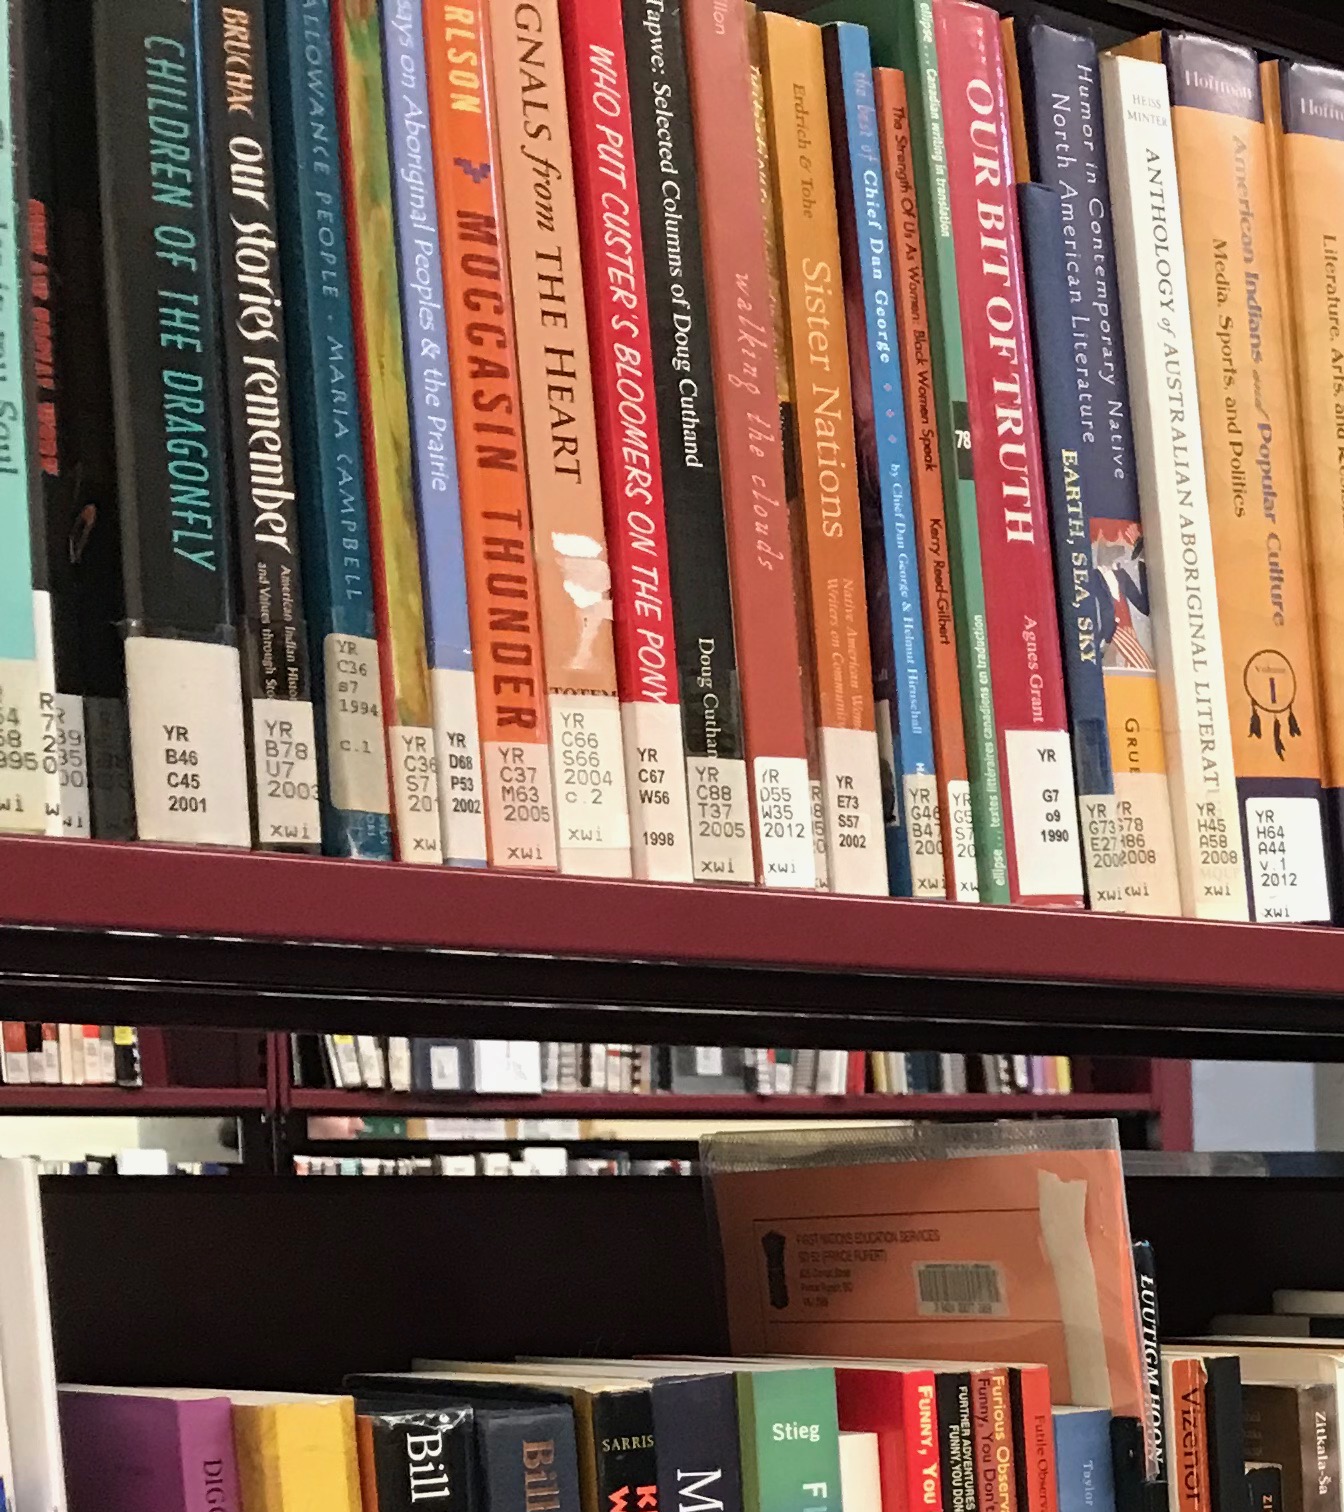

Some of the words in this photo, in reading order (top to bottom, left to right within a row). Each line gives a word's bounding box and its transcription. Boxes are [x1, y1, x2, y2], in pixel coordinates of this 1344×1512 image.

[222, 6, 253, 118] BRUCHAC
[590, 44, 620, 118] WHO
[144, 35, 193, 208] CHILDREN
[653, 81, 679, 176] Selected
[967, 78, 1001, 188] OUR
[1052, 93, 1077, 169] North
[1076, 64, 1095, 152] Humor
[228, 136, 268, 209] our
[596, 123, 627, 189] PUT
[1085, 162, 1096, 184] in
[153, 225, 197, 271] OF
[661, 180, 683, 278] Columns
[977, 199, 1011, 288] BIT
[1059, 180, 1082, 304] American
[230, 213, 281, 341] stories
[671, 284, 689, 309] of
[802, 257, 830, 372] Sister
[1088, 199, 1115, 387] Contemporary
[158, 289, 201, 352] THE
[457, 210, 518, 472] MOCCASIN
[671, 312, 692, 371] Doug
[985, 296, 1019, 366] OF
[1070, 315, 1095, 445] Literature
[242, 356, 295, 554] remember
[611, 341, 652, 507] BLOOMERS
[678, 377, 703, 468] Cuthand
[812, 383, 843, 538] Nations
[992, 369, 1035, 545] TRUTH
[1107, 400, 1124, 480] Native
[162, 369, 216, 571] DRAGONFLY
[626, 510, 659, 557] ON
[482, 508, 538, 729] THUNDER
[632, 565, 661, 622] THE
[163, 725, 189, 742] YR
[165, 750, 198, 766] B46
[167, 773, 200, 789] C45
[168, 796, 207, 813] 2001
[407, 1432, 450, 1503] Bill
[602, 1434, 654, 1452] SARRIS
[772, 1422, 820, 1442] Stieg
